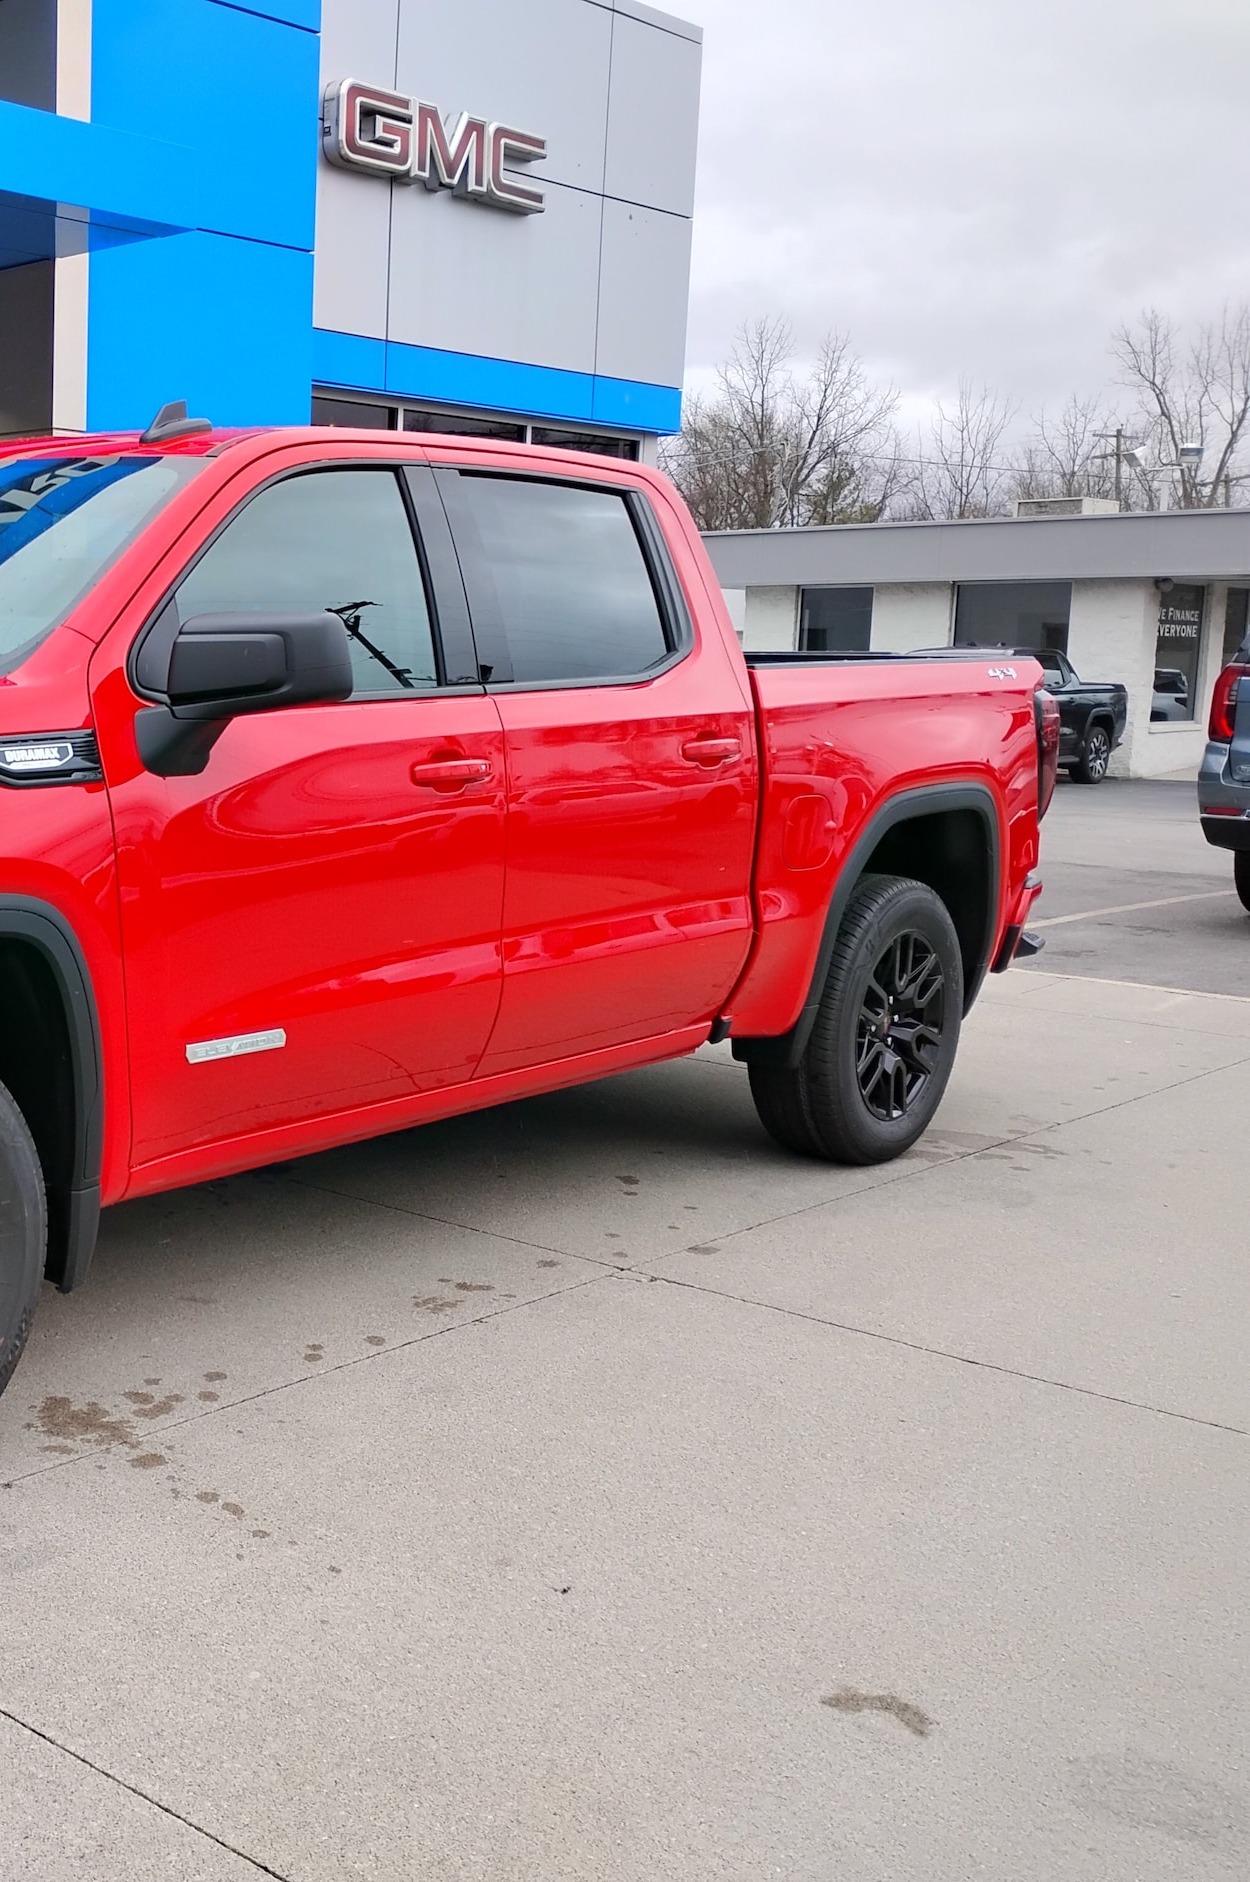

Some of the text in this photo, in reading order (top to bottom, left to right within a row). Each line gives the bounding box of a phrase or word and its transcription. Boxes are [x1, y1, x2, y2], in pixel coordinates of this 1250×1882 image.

[324, 78, 547, 215] GMC
[1168, 607, 1200, 621] FINANCE
[4, 747, 61, 762] DURAMAX
